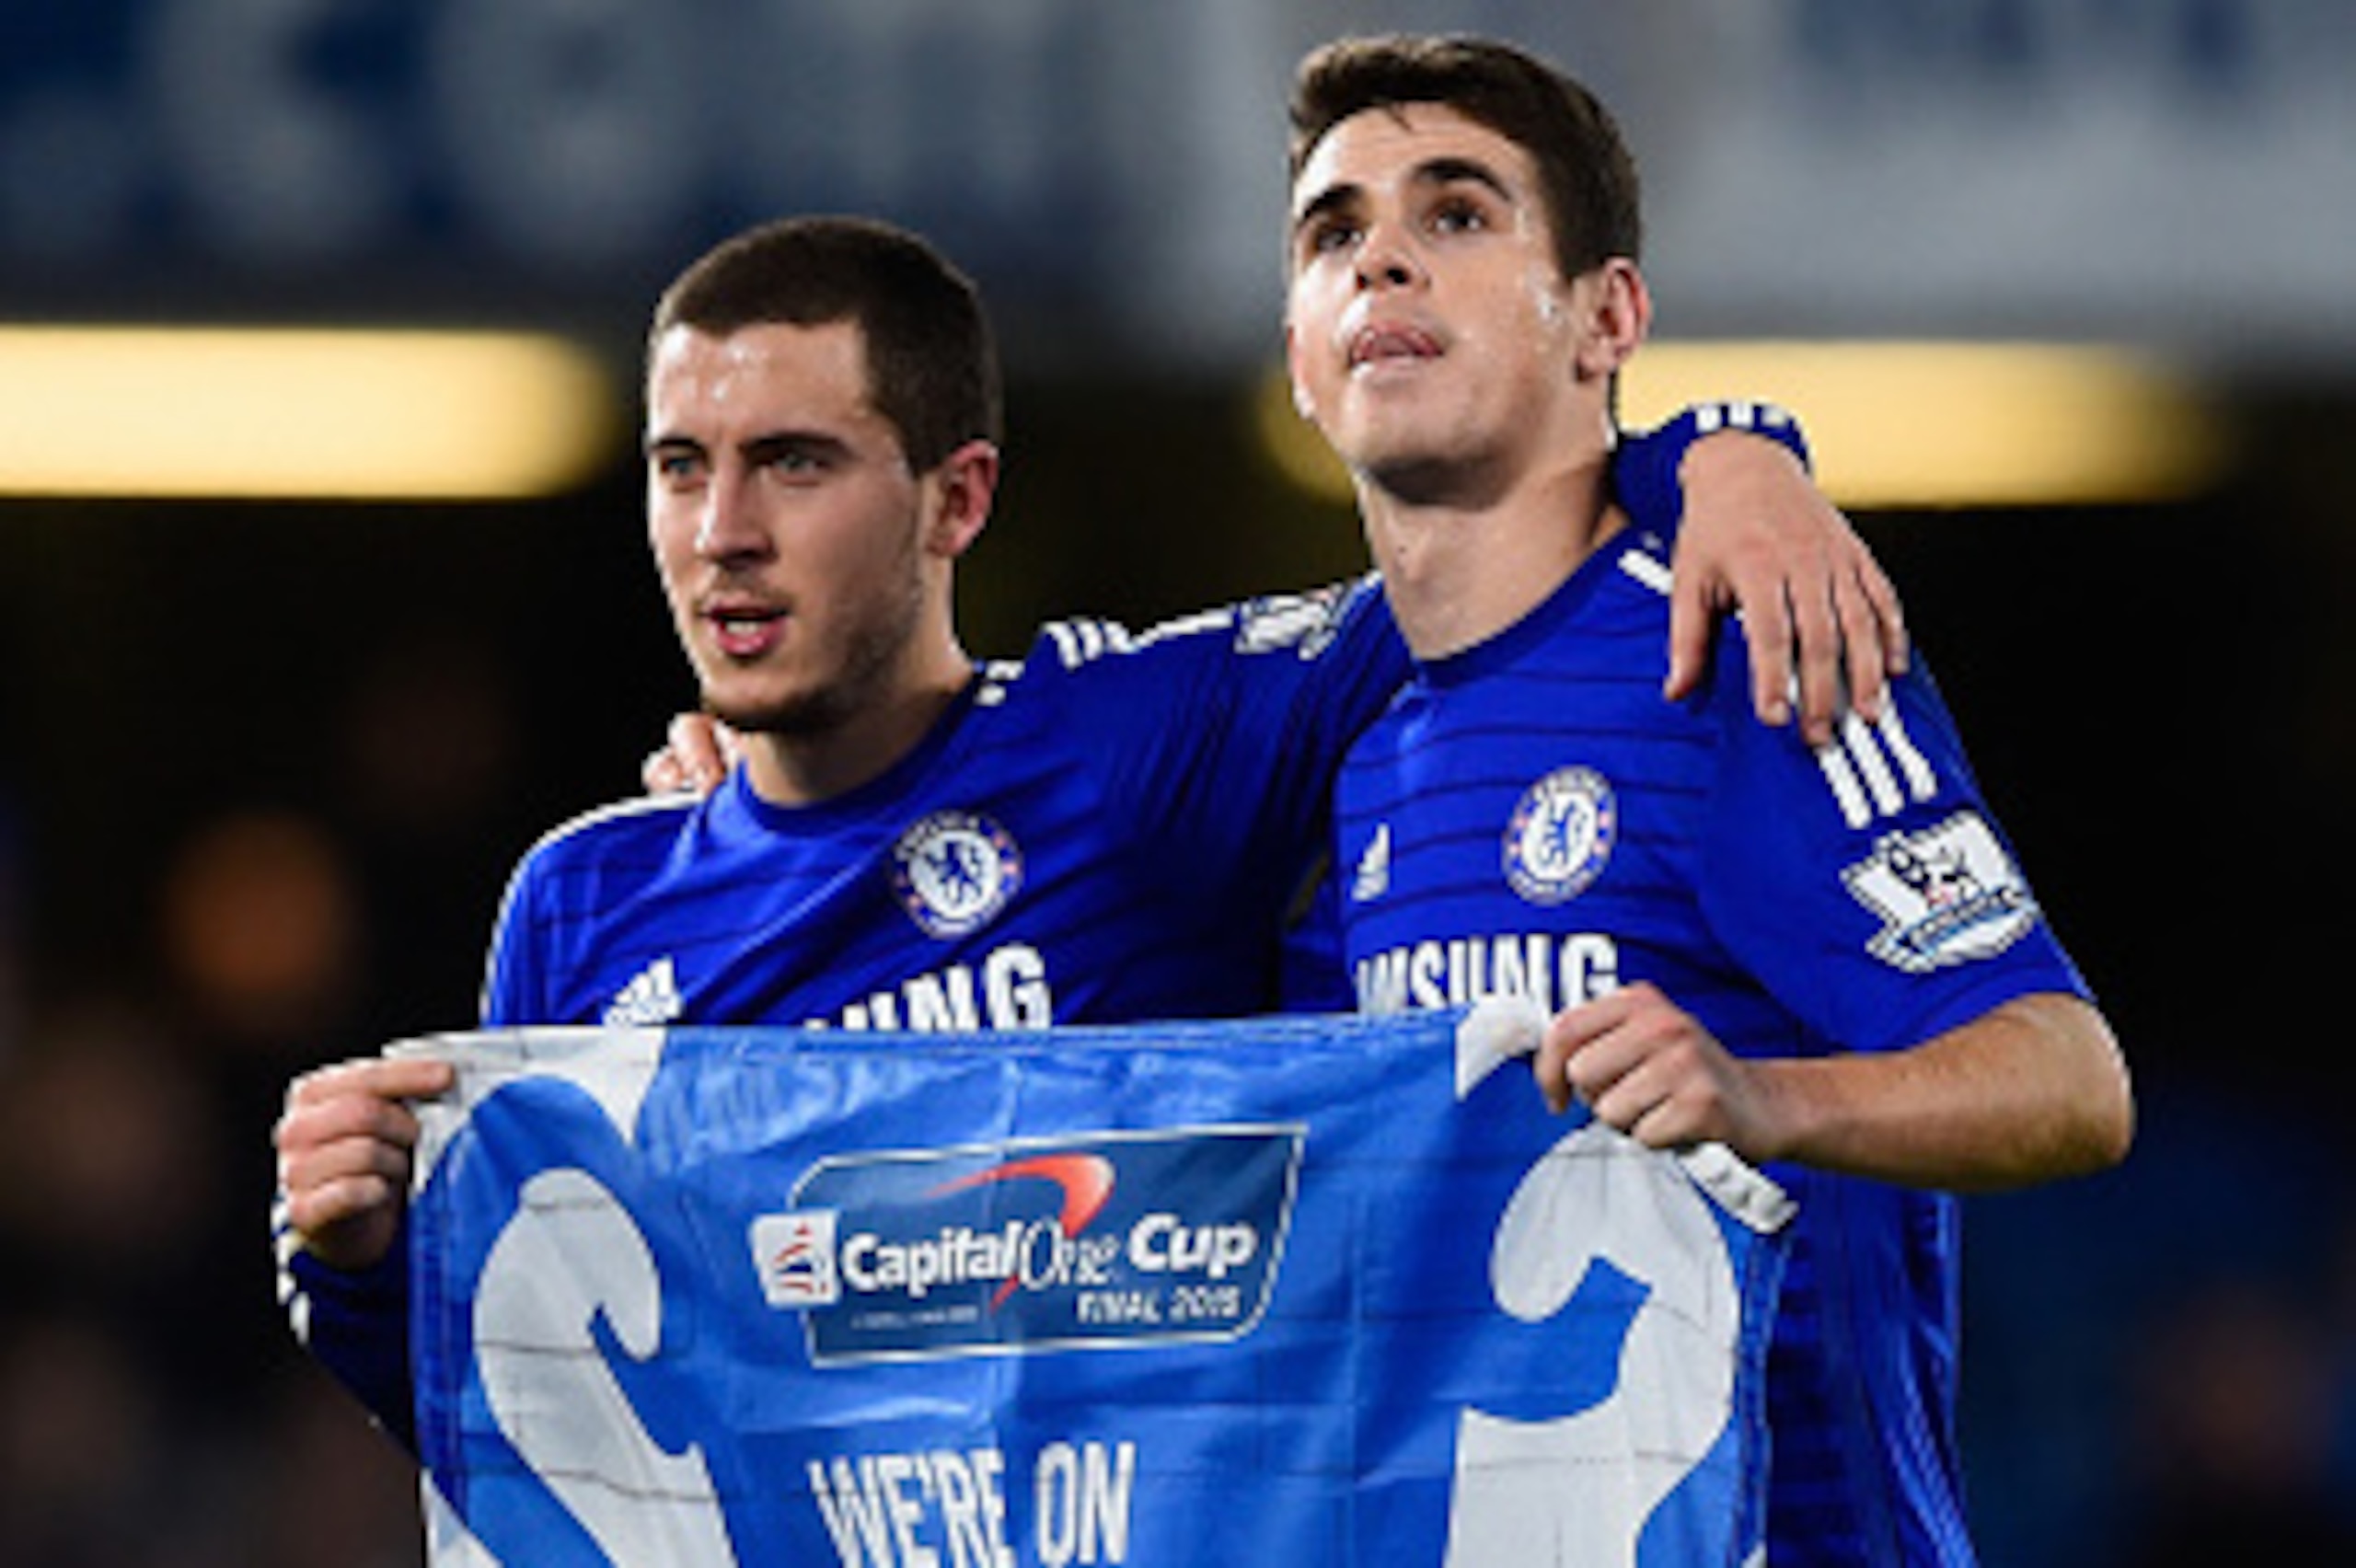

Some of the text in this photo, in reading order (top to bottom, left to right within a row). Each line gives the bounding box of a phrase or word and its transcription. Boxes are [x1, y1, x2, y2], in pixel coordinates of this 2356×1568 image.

[1128, 1212, 1258, 1280] Cup
[1077, 1290, 1161, 1323] FINAL
[806, 1441, 1136, 1568] WE'RE ON
